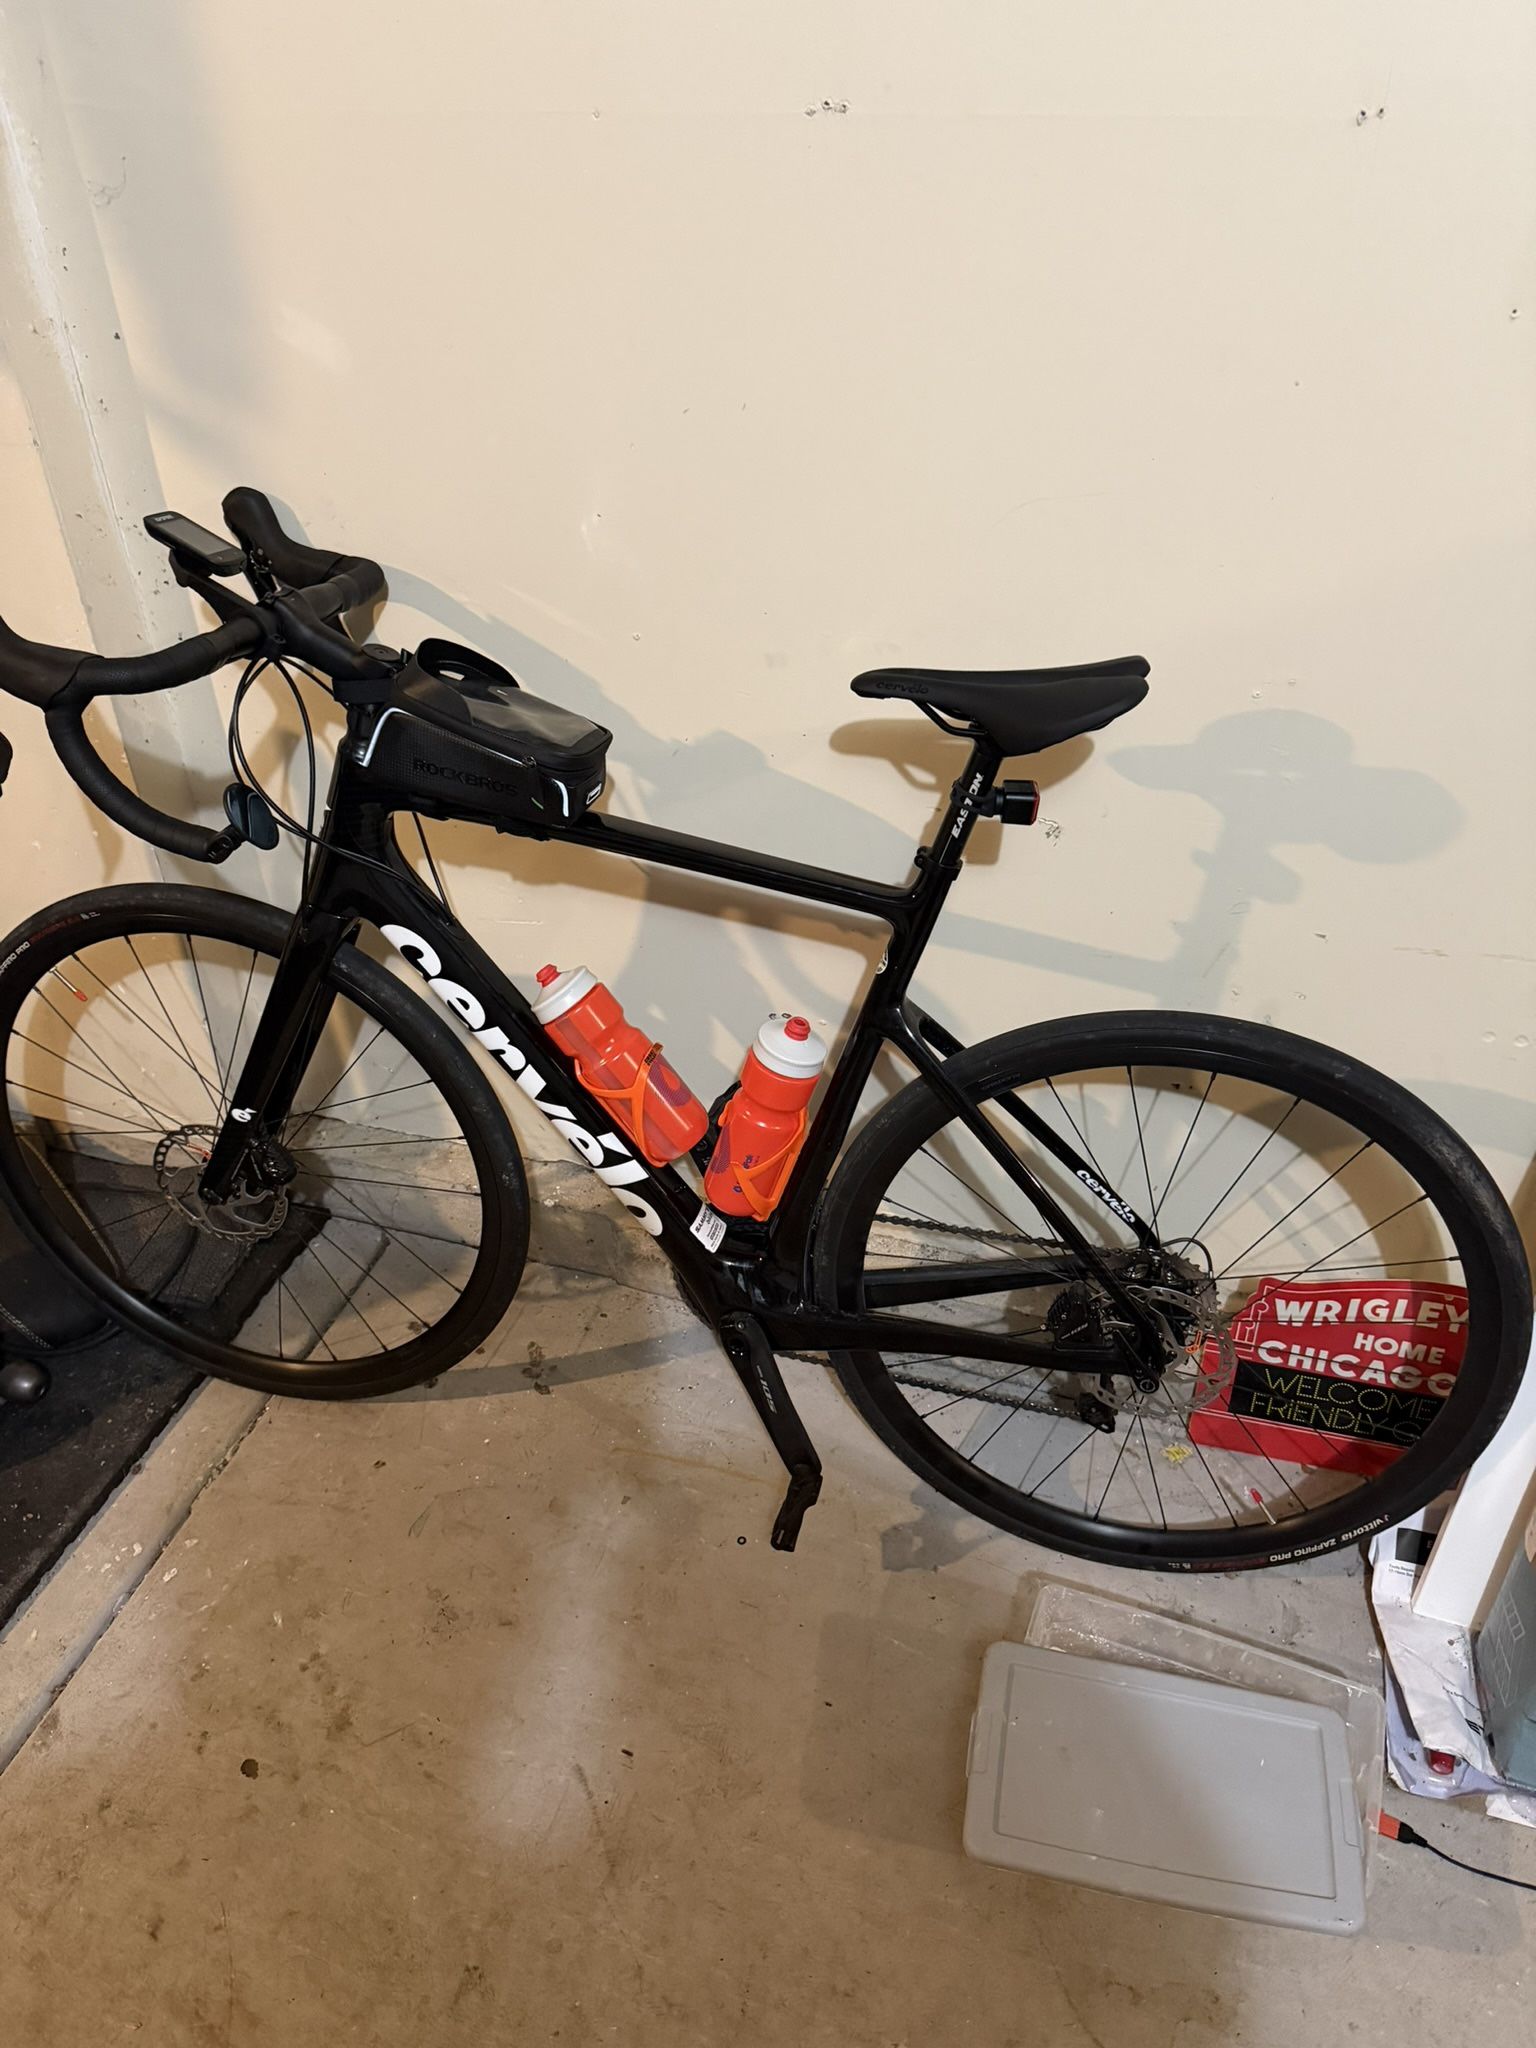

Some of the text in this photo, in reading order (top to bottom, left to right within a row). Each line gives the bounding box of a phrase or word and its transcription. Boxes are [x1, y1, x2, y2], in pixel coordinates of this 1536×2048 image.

[413, 758, 520, 797] ROCKBROS
[1274, 1297, 1469, 1334] WRIGLEY
[1257, 1339, 1457, 1397] CHICAGO
[1353, 1331, 1446, 1366] HOME
[1264, 1367, 1438, 1421] WELCOME
